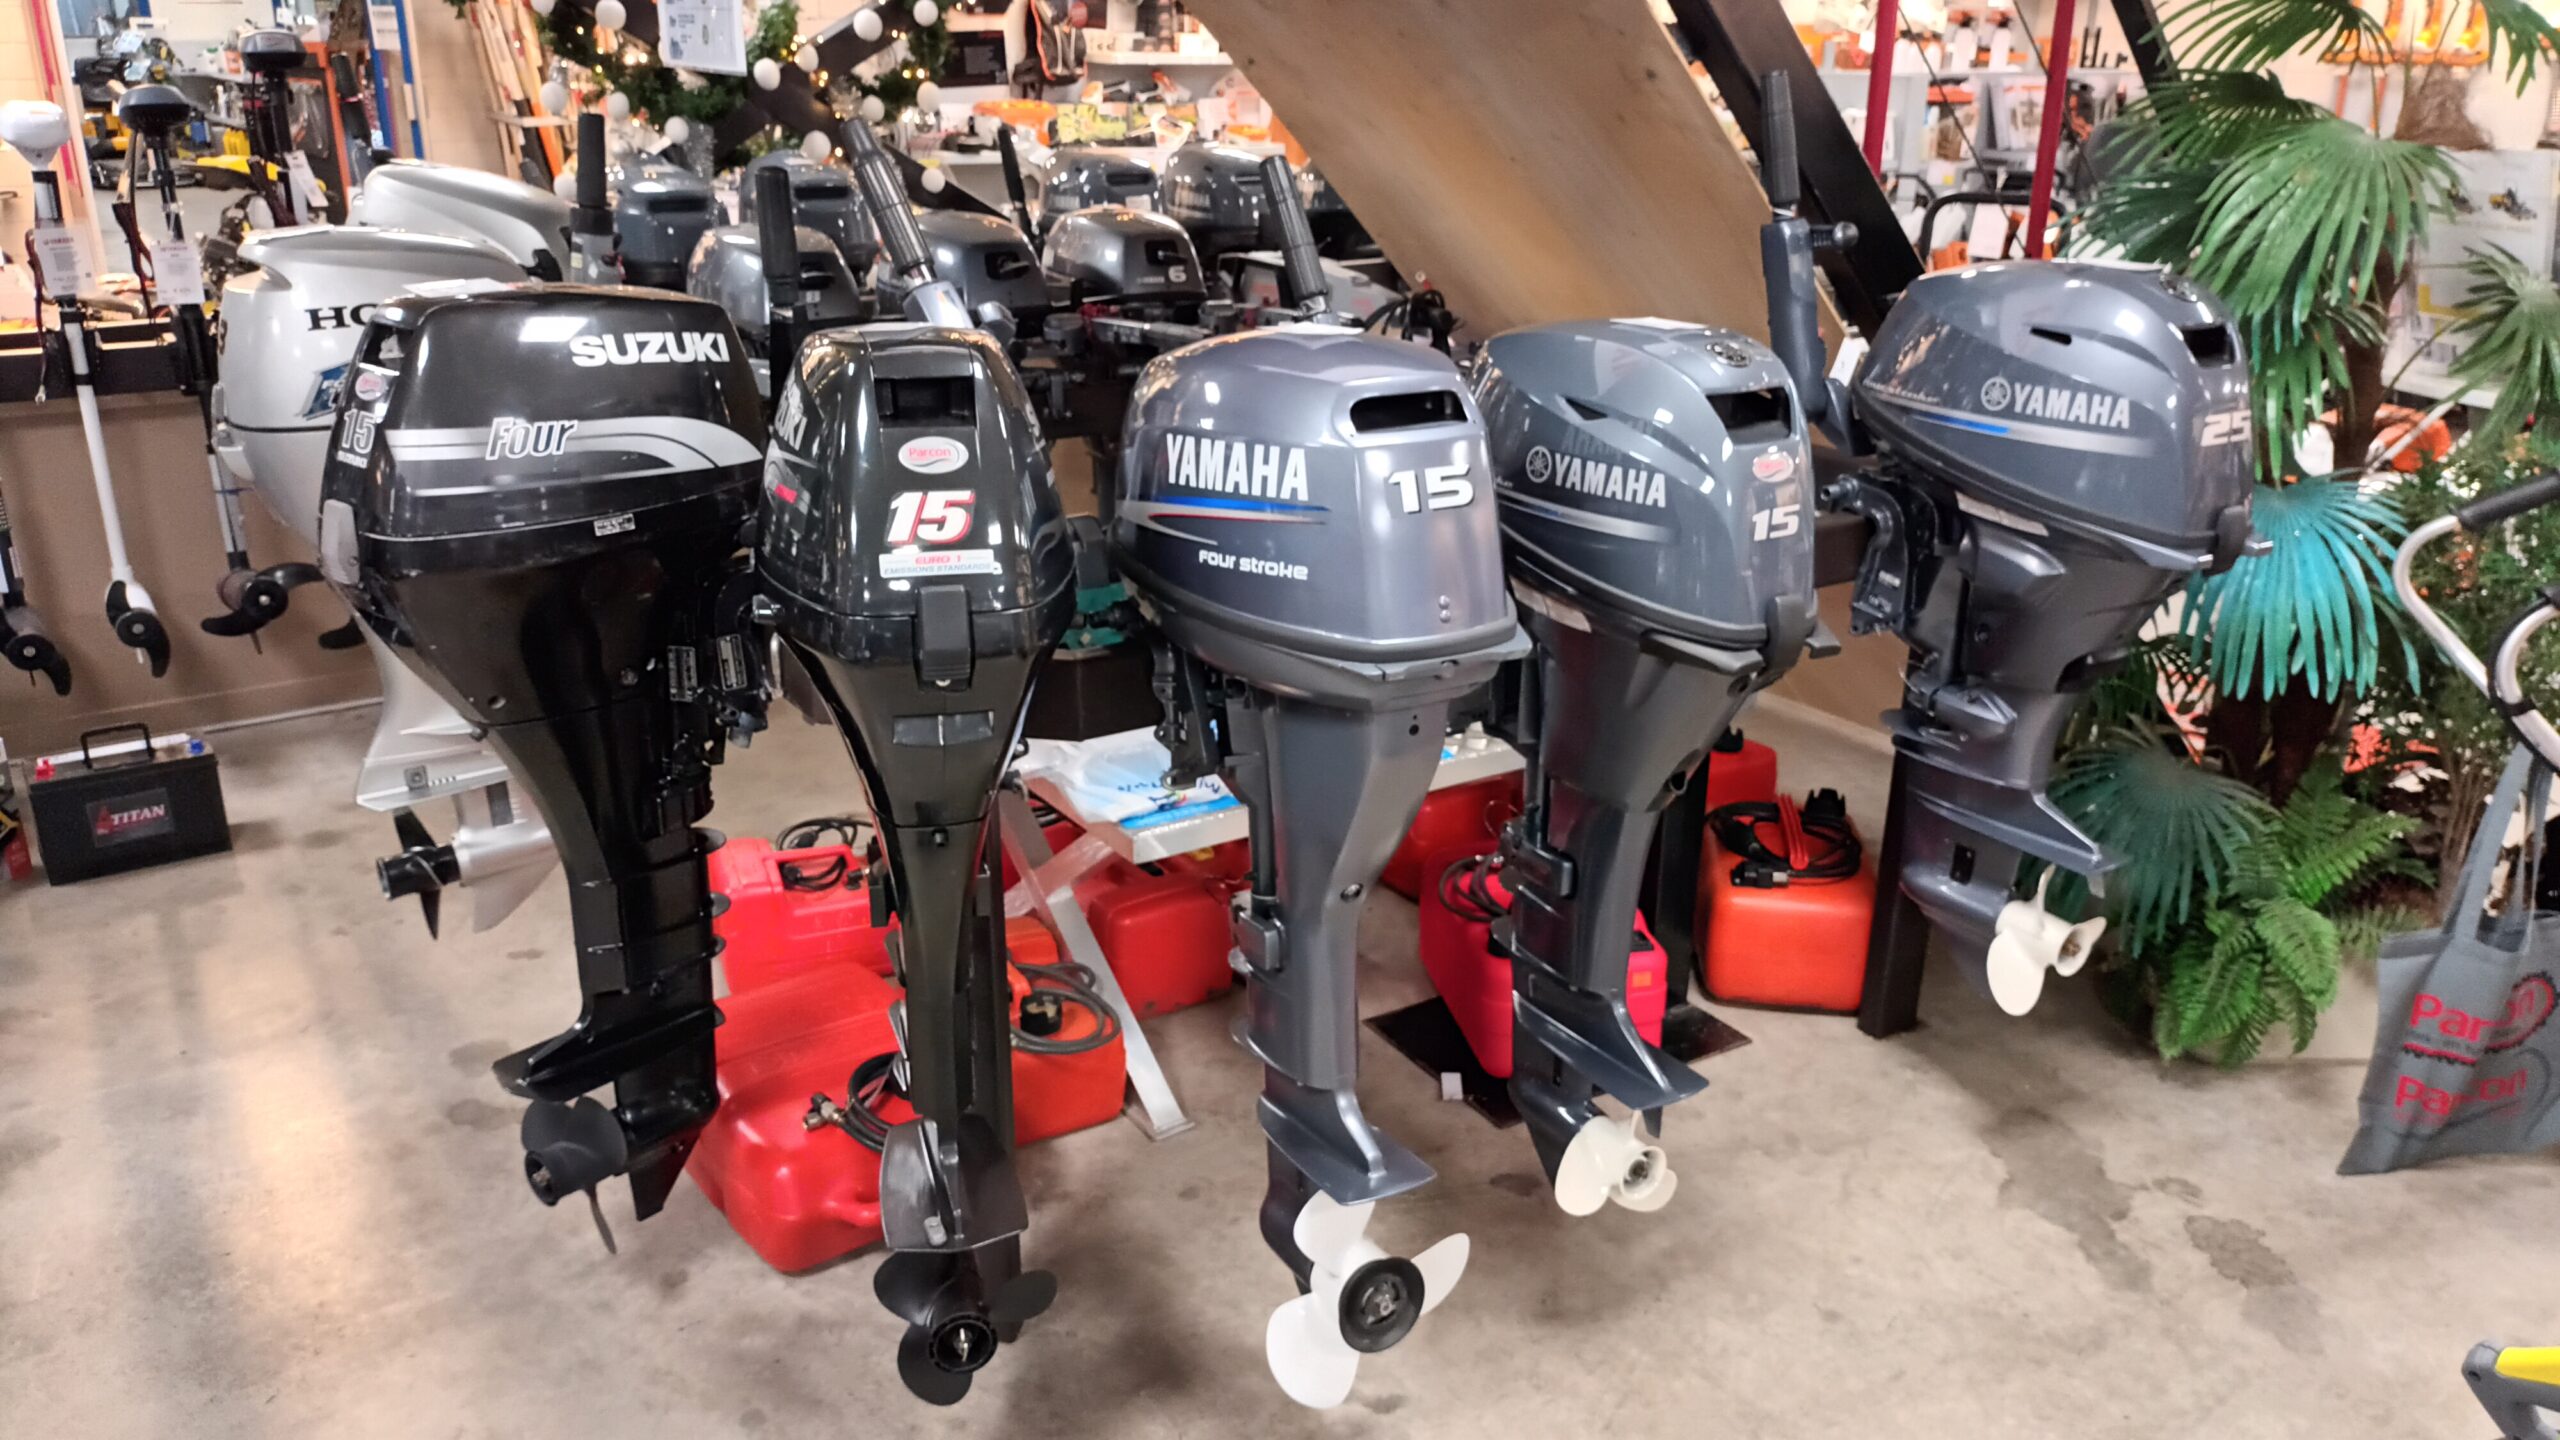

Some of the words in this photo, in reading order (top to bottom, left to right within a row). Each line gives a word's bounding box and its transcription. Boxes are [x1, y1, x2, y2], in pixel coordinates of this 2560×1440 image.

[1167, 264, 1188, 283] 6
[569, 331, 731, 367] SUZUKI
[2012, 381, 2131, 430] YAMAHA
[341, 408, 377, 455] 15
[484, 416, 579, 461] Four
[2199, 408, 2251, 448] 25
[908, 446, 952, 458] Parcon
[1165, 432, 1310, 502] YAMAHA
[1387, 463, 1476, 514] 15
[1554, 452, 1667, 509] YAMAHA
[886, 489, 977, 546] 15
[1751, 503, 1801, 542] 15
[884, 565, 936, 577] EMISSIONS
[936, 562, 992, 575] STANDARDS
[914, 554, 952, 566] EURO
[111, 803, 166, 826] TITAN
